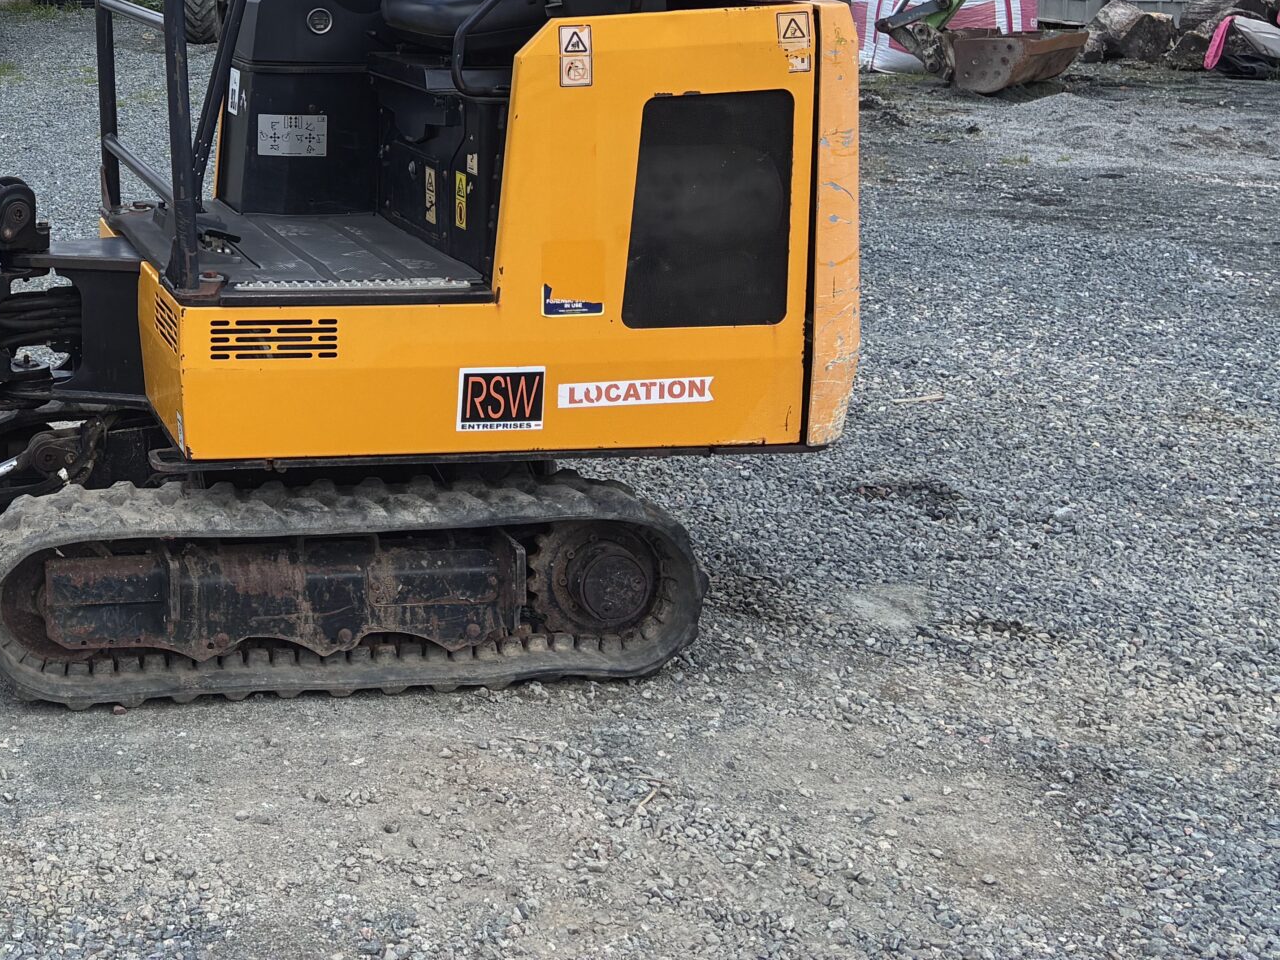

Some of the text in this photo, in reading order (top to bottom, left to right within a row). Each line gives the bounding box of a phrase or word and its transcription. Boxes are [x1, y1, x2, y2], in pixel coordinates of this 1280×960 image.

[466, 375, 540, 419] RSW
[568, 379, 706, 404] LOCATION
[461, 422, 532, 430] ENTREPRISES
